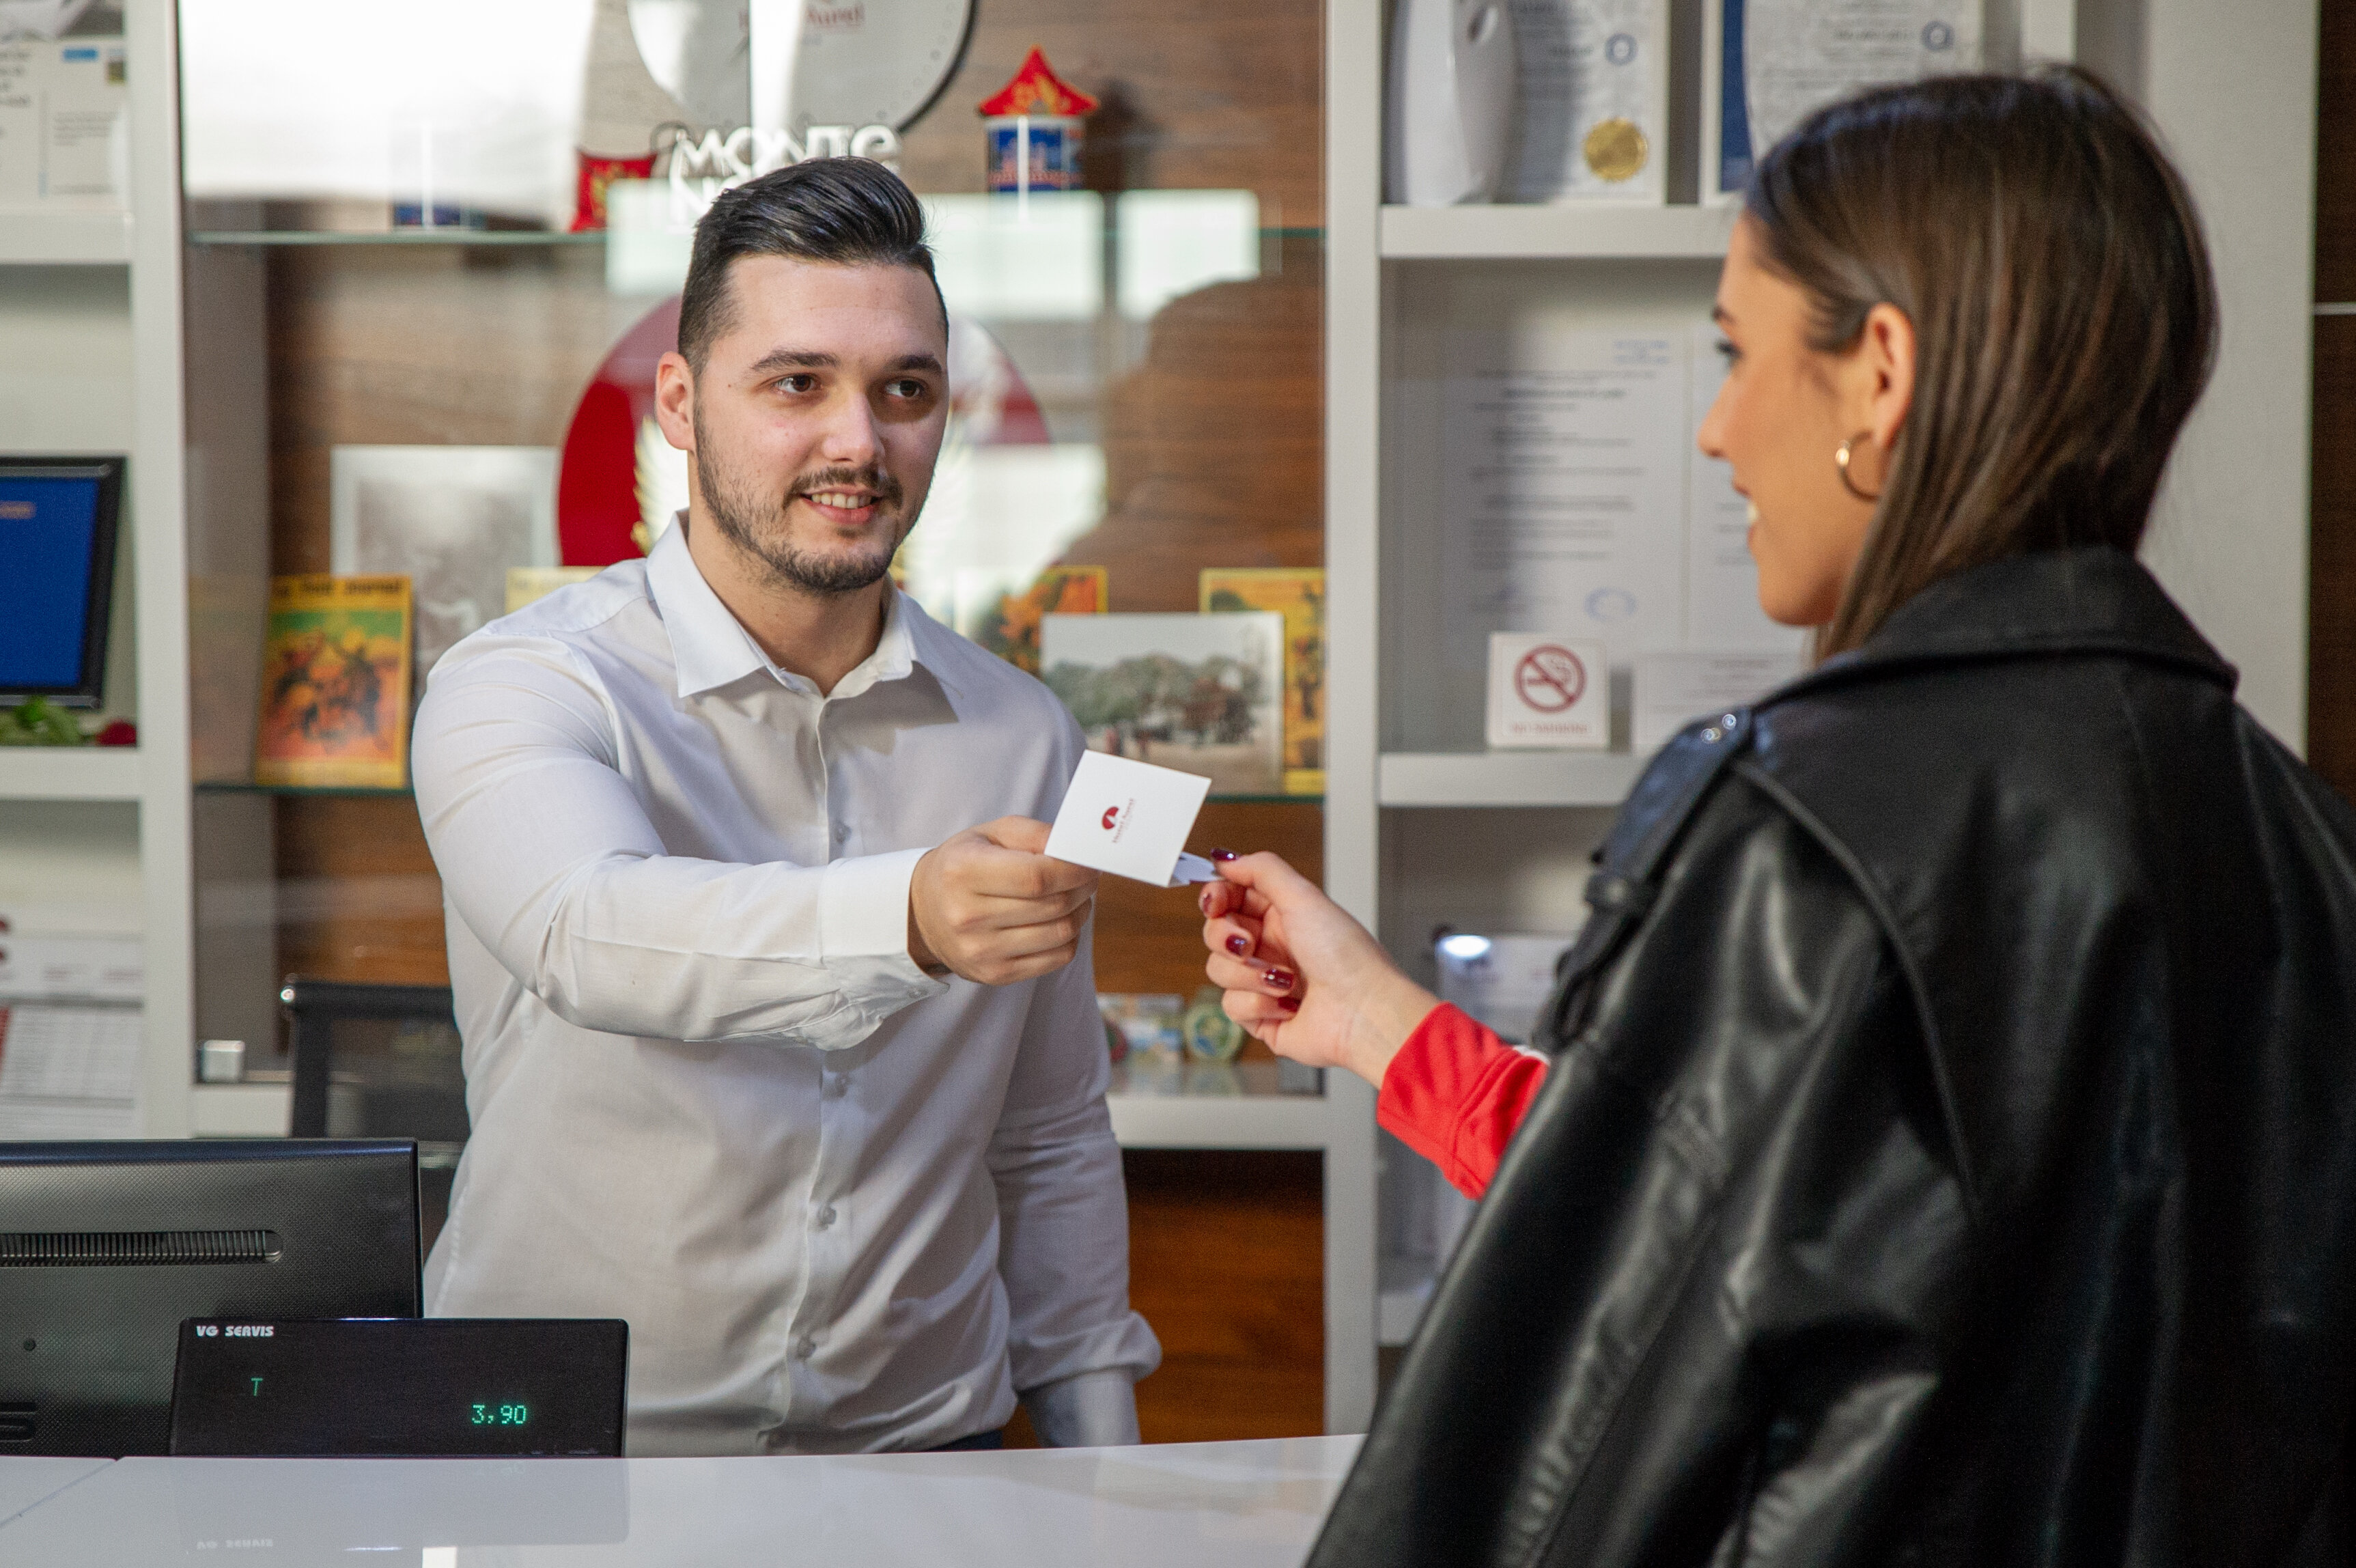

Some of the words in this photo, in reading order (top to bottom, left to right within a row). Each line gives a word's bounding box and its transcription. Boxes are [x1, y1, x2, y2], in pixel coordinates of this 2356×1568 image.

[196, 1326, 219, 1336] VG
[225, 1326, 274, 1336] SERVIS
[251, 1377, 263, 1397] T
[472, 1404, 527, 1424] 3,90
